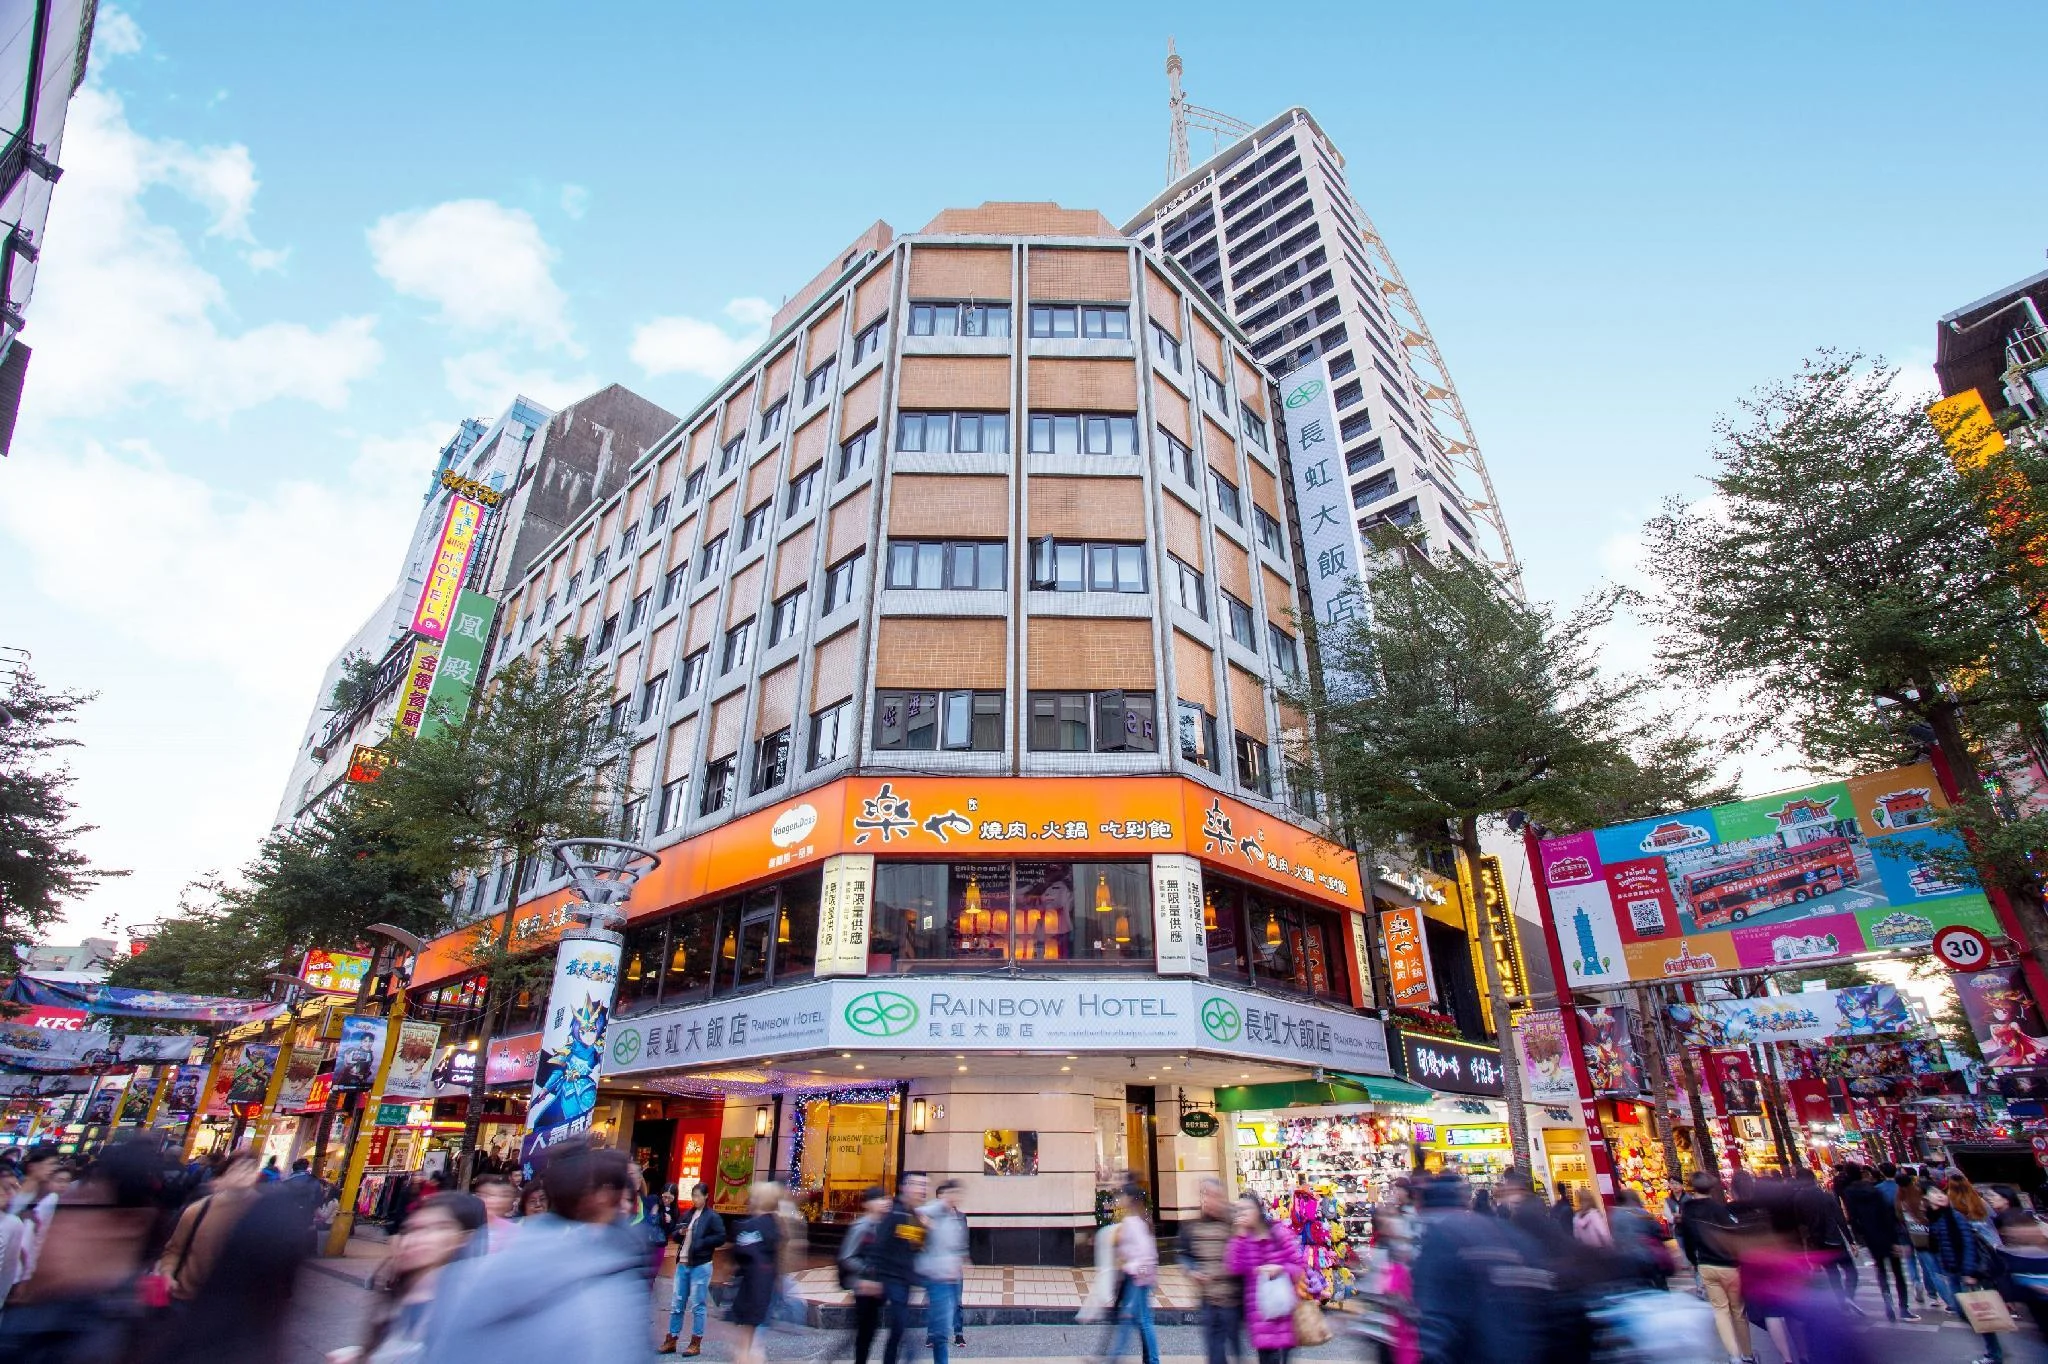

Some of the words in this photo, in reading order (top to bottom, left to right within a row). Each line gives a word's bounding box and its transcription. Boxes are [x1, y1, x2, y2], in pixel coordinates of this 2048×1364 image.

[1299, 419, 1356, 623] 長虹大飯店
[426, 550, 454, 614] HOTEL
[1099, 819, 1173, 841] 吃到飽
[1625, 867, 1646, 878] Taipei
[1318, 872, 1348, 897] 吃到飽
[1722, 879, 1753, 894] Taipei
[850, 880, 866, 945] 無限量供應
[1166, 879, 1183, 943] 無限量供應
[1946, 939, 1978, 958] 30
[929, 992, 1064, 1017] RAINBOW
[1078, 992, 1177, 1017] HOTEL
[34, 1016, 83, 1031] KFC
[751, 1016, 791, 1032] RAINBOW
[792, 1010, 824, 1027] HOTEL
[929, 1021, 1033, 1038] 長虹大飯店
[1244, 1007, 1332, 1053] 長虹大飯店
[645, 1011, 749, 1058] 長虹大飯店
[1333, 1033, 1364, 1049] RAINBOW
[1365, 1036, 1386, 1052] HOTEL
[1583, 1109, 1595, 1119] W
[1587, 1125, 1600, 1135] 16
[1721, 1122, 1730, 1131] W
